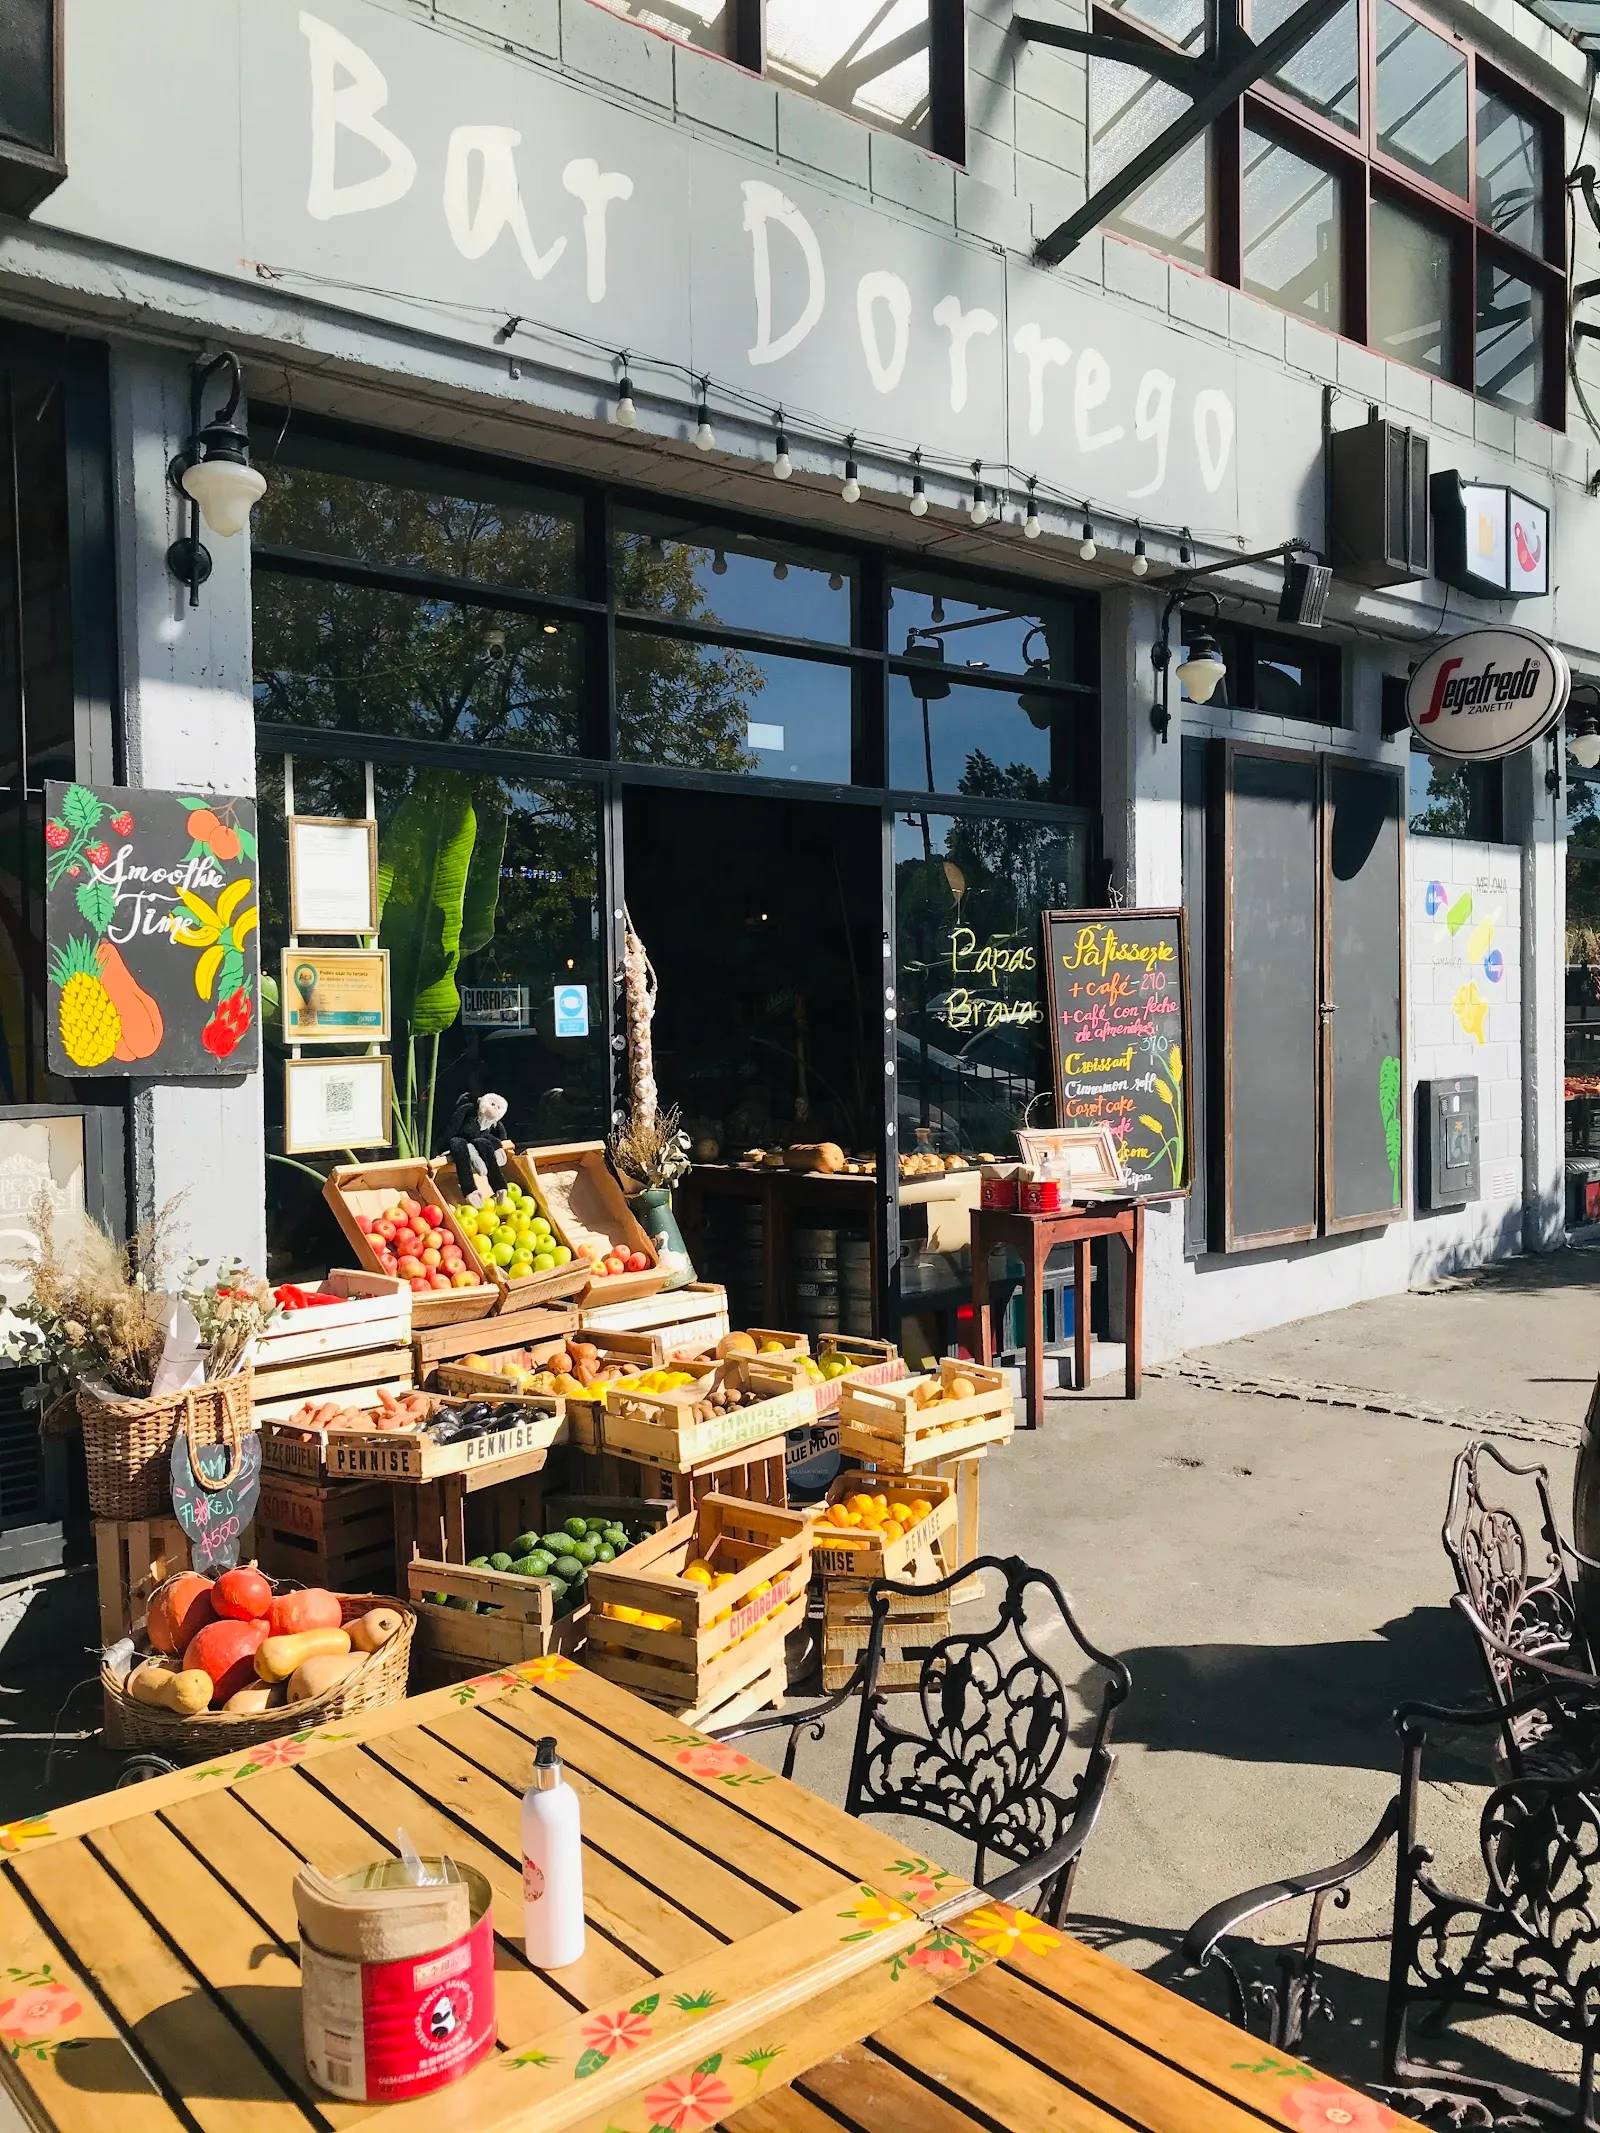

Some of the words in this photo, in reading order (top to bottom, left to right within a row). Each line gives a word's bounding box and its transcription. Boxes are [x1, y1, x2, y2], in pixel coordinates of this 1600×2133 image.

[298, 9, 634, 304] Bar
[740, 180, 1235, 499] Dorrego
[1419, 656, 1540, 725] Segafredo
[1468, 701, 1514, 715] ZANETTI
[87, 844, 226, 898] Smoothie
[107, 890, 208, 945] Time
[950, 927, 1036, 987] Papas
[464, 990, 500, 1012] CLOSED
[1114, 1006, 1139, 1019] con
[1065, 1047, 1137, 1075] Croissant
[1065, 1080, 1128, 1099] Cinnamon
[1106, 1096, 1137, 1116] cake
[1122, 1166, 1153, 1191] hipa
[467, 1426, 533, 1463] PENNISE
[784, 1444, 808, 1466] LUE
[338, 1450, 410, 1472] PENNISE
[201, 1516, 240, 1561] $500
[905, 1512, 940, 1559] PENNISE
[812, 1549, 855, 1572] NNISE
[730, 1576, 792, 1639] CITRORGANIC
